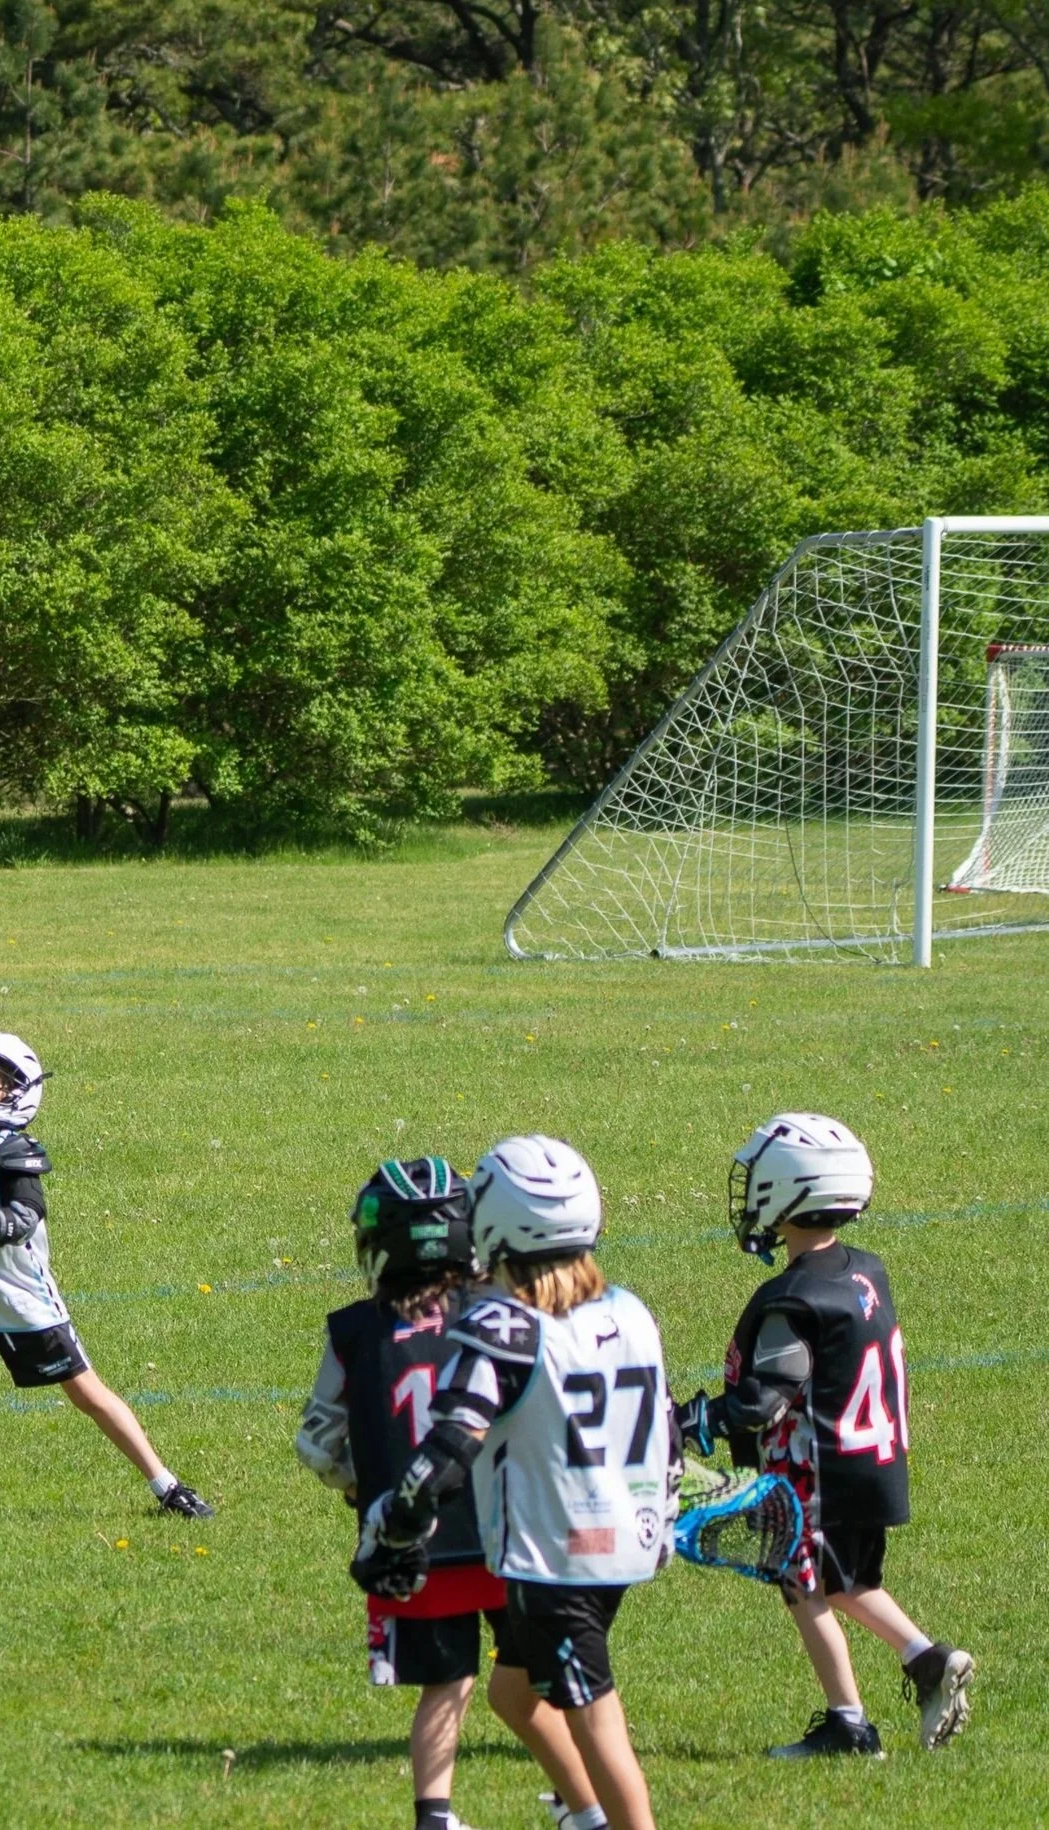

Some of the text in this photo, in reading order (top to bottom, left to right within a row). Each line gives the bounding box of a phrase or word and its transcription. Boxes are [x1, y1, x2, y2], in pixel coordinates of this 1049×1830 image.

[24, 1159, 42, 1168] STX
[562, 1366, 658, 1468] 27
[399, 1453, 434, 1508] STX
